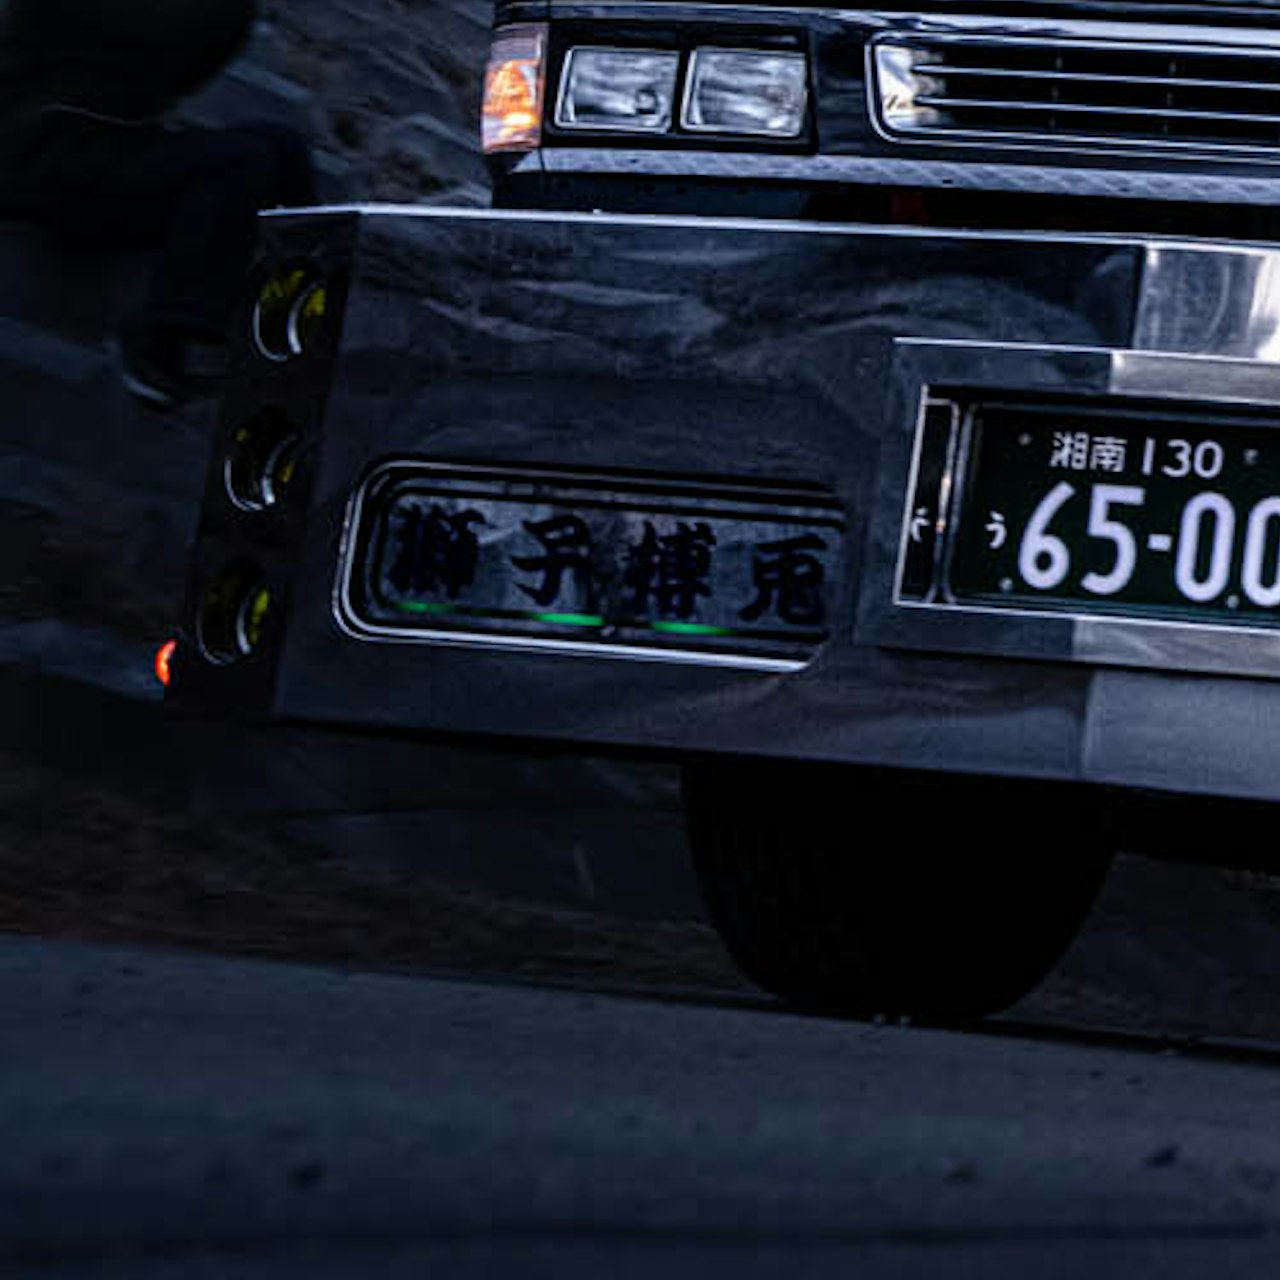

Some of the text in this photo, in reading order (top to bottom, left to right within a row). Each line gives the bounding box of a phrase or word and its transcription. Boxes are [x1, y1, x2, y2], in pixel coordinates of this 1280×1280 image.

[1049, 431, 1225, 479] 湘南 130
[985, 511, 1007, 549] う
